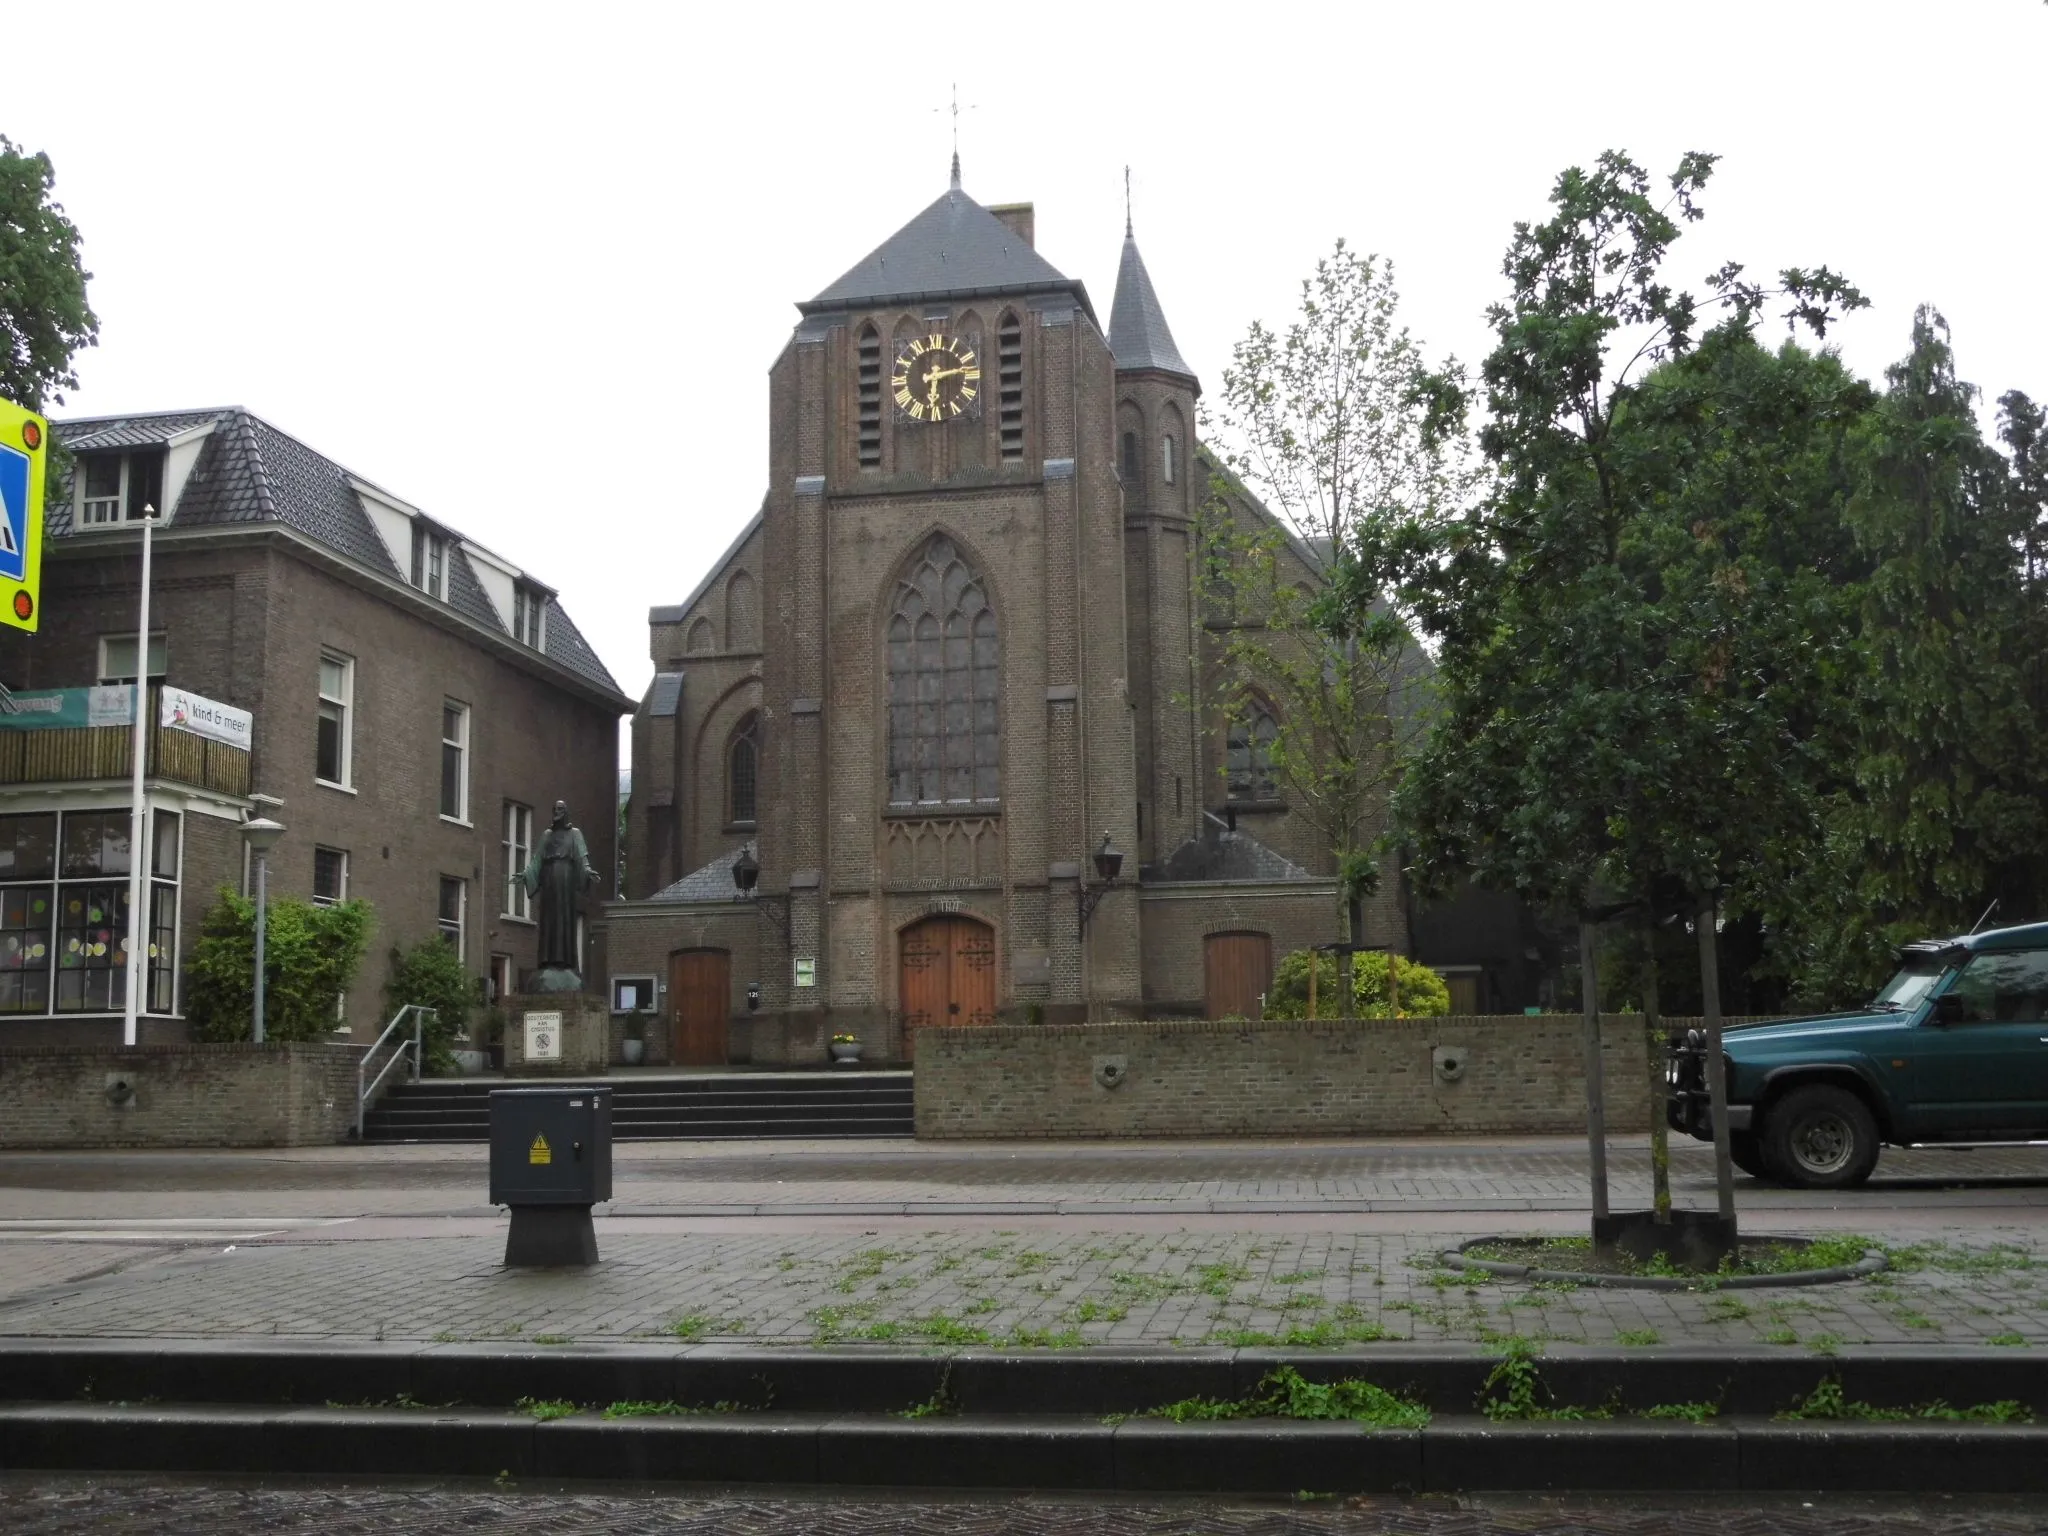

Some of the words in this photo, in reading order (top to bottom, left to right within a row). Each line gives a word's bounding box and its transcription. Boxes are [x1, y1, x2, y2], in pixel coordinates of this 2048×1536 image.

[910, 340, 924, 356] XI
[929, 334, 942, 349] XII
[949, 338, 958, 352] I
[897, 356, 912, 368] X
[960, 351, 975, 364] II
[891, 376, 906, 386] IX
[909, 401, 924, 419] VII
[931, 406, 942, 421] VI
[950, 401, 962, 415] V
[192, 703, 212, 722] kind
[214, 711, 223, 725] &
[224, 717, 246, 732] meer
